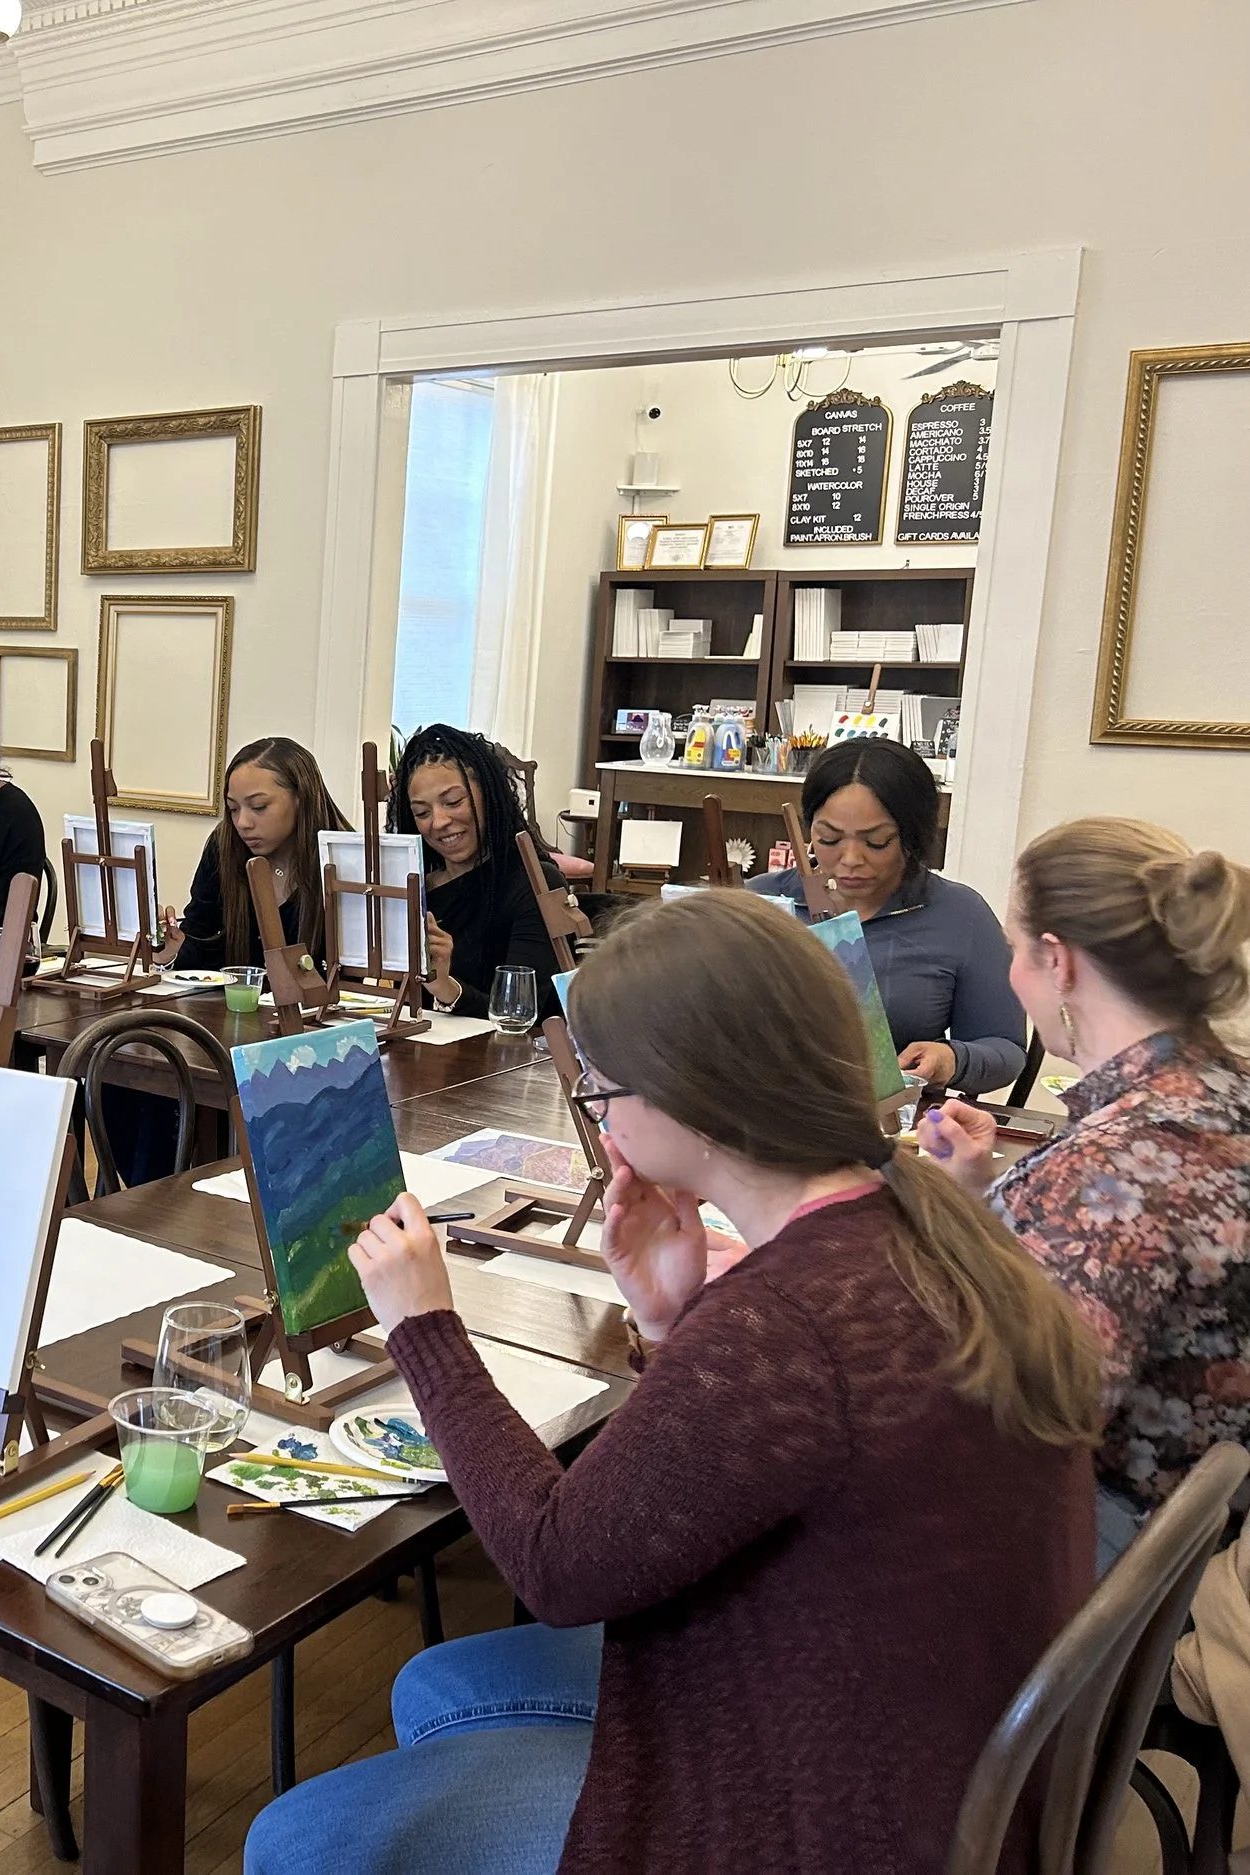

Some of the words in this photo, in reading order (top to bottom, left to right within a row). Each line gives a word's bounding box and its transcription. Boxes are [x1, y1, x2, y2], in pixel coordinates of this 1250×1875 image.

[940, 403, 976, 413] COFFEE
[825, 410, 858, 420] CANVAS
[811, 427, 841, 436] BOARD
[842, 423, 882, 433] STRETCH
[911, 420, 959, 432] ESPRESSO
[979, 418, 986, 427] 3
[910, 429, 963, 440] AMERICANO
[909, 438, 962, 448] MACCHIATO
[908, 446, 953, 457] CORTADO
[977, 445, 983, 453] 4
[908, 453, 967, 464] CAPPUCCINO
[795, 467, 839, 478] SKETCHED
[908, 463, 939, 473] LATTE
[907, 471, 942, 480] MOCHA
[808, 480, 863, 491] WATERCOLOR
[907, 479, 939, 488] HOUSE
[906, 487, 937, 496] DECAF
[905, 494, 954, 504] POUROVER
[972, 493, 979, 502] 5
[832, 501, 841, 510] 12
[903, 503, 936, 513] SINGLE
[938, 502, 970, 511] ORIGIN
[789, 516, 812, 525] CLAY
[813, 515, 827, 524] KIT
[853, 513, 862, 522] 12
[813, 526, 854, 534] INCLUDED
[897, 532, 918, 542] GIFT
[919, 532, 949, 541] CARDS
[949, 531, 980, 541] AVAILA
